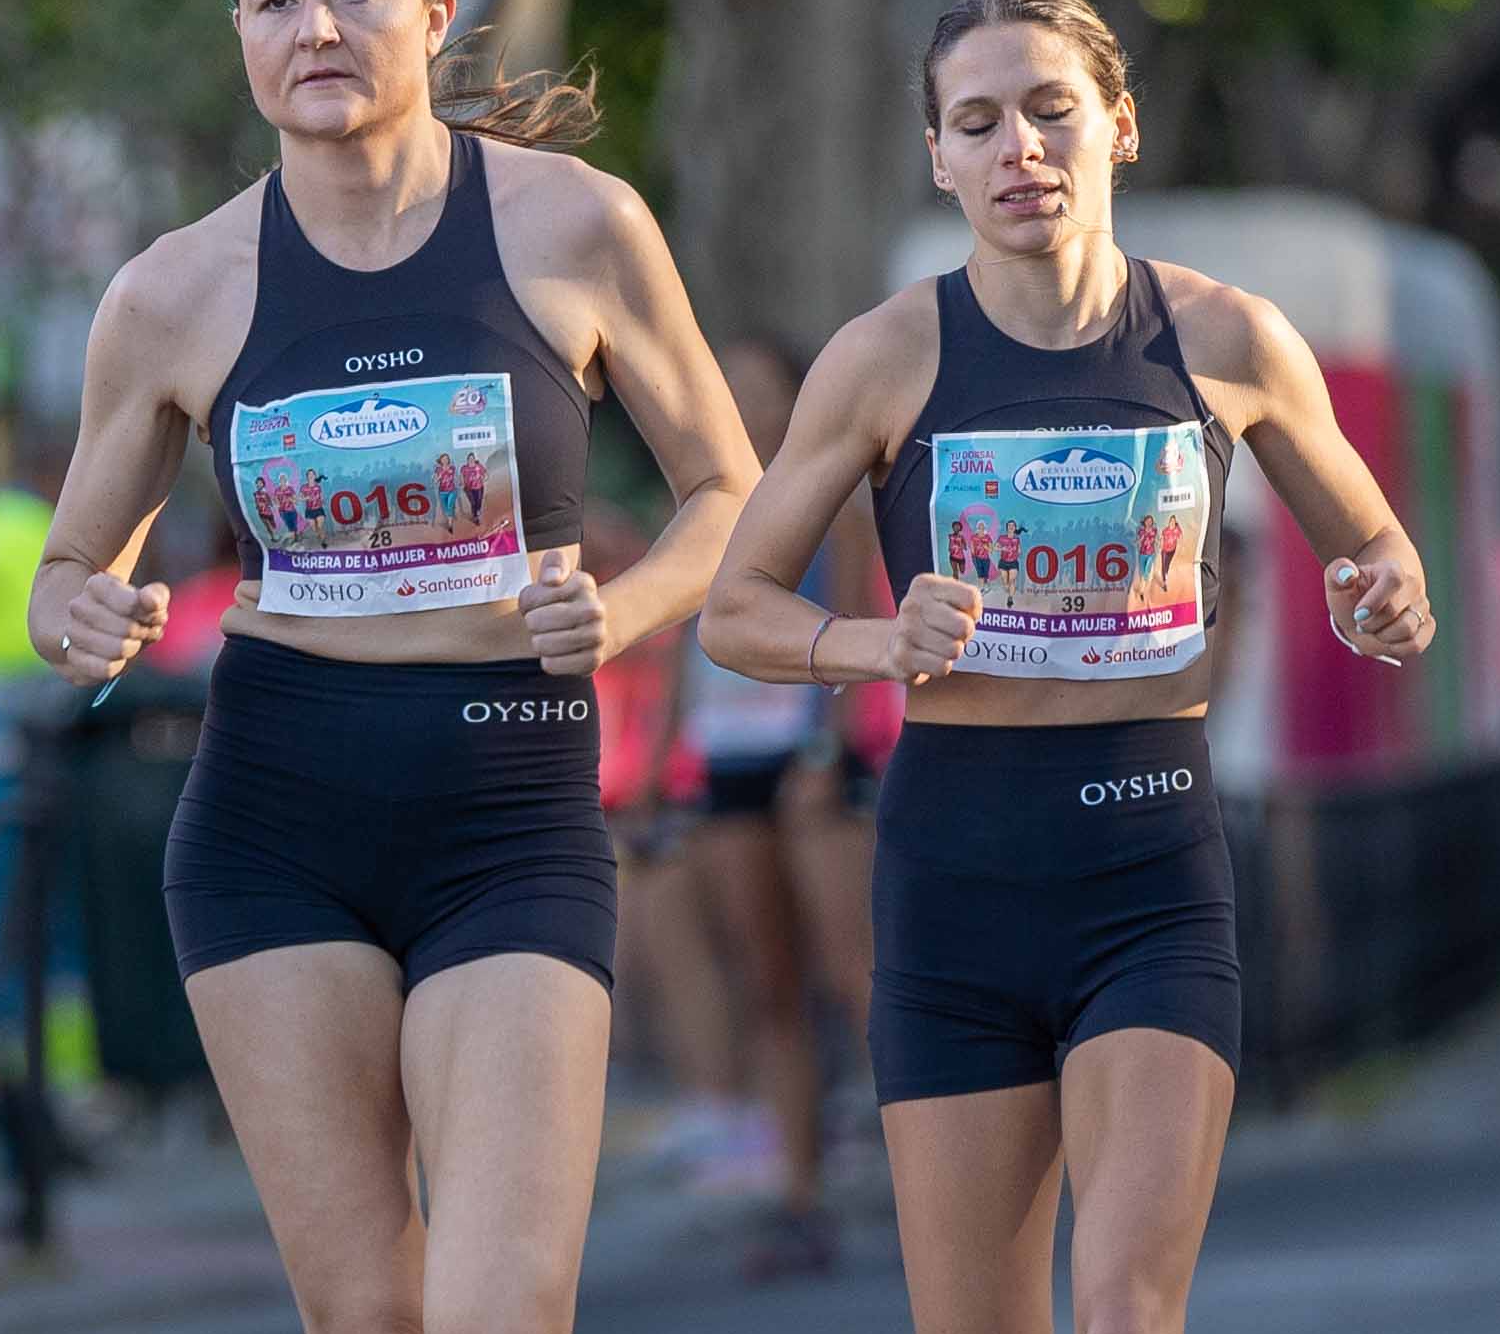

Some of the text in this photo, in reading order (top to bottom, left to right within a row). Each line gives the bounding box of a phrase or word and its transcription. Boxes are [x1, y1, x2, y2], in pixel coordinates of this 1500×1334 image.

[345, 348, 424, 373] OYSHO
[456, 389, 480, 406] 20
[318, 416, 420, 441] ASTURIANA
[951, 459, 994, 474] SUMA
[1022, 469, 1128, 493] ASTURIANA
[330, 483, 430, 525] 016
[369, 530, 392, 549] 28
[345, 553, 361, 568] DE
[364, 553, 379, 569] LA
[382, 547, 426, 566] MUJER
[436, 540, 490, 560] MADRID
[1025, 543, 1130, 585] 016
[289, 574, 499, 602] OYSHO Santander
[1061, 595, 1085, 613] 39
[975, 611, 1173, 633] ARRERA DE LA MUJER MADRID
[964, 639, 1177, 665] OYSHO Santander
[462, 700, 588, 723] OYSHO
[1080, 768, 1192, 806] OYSHO
